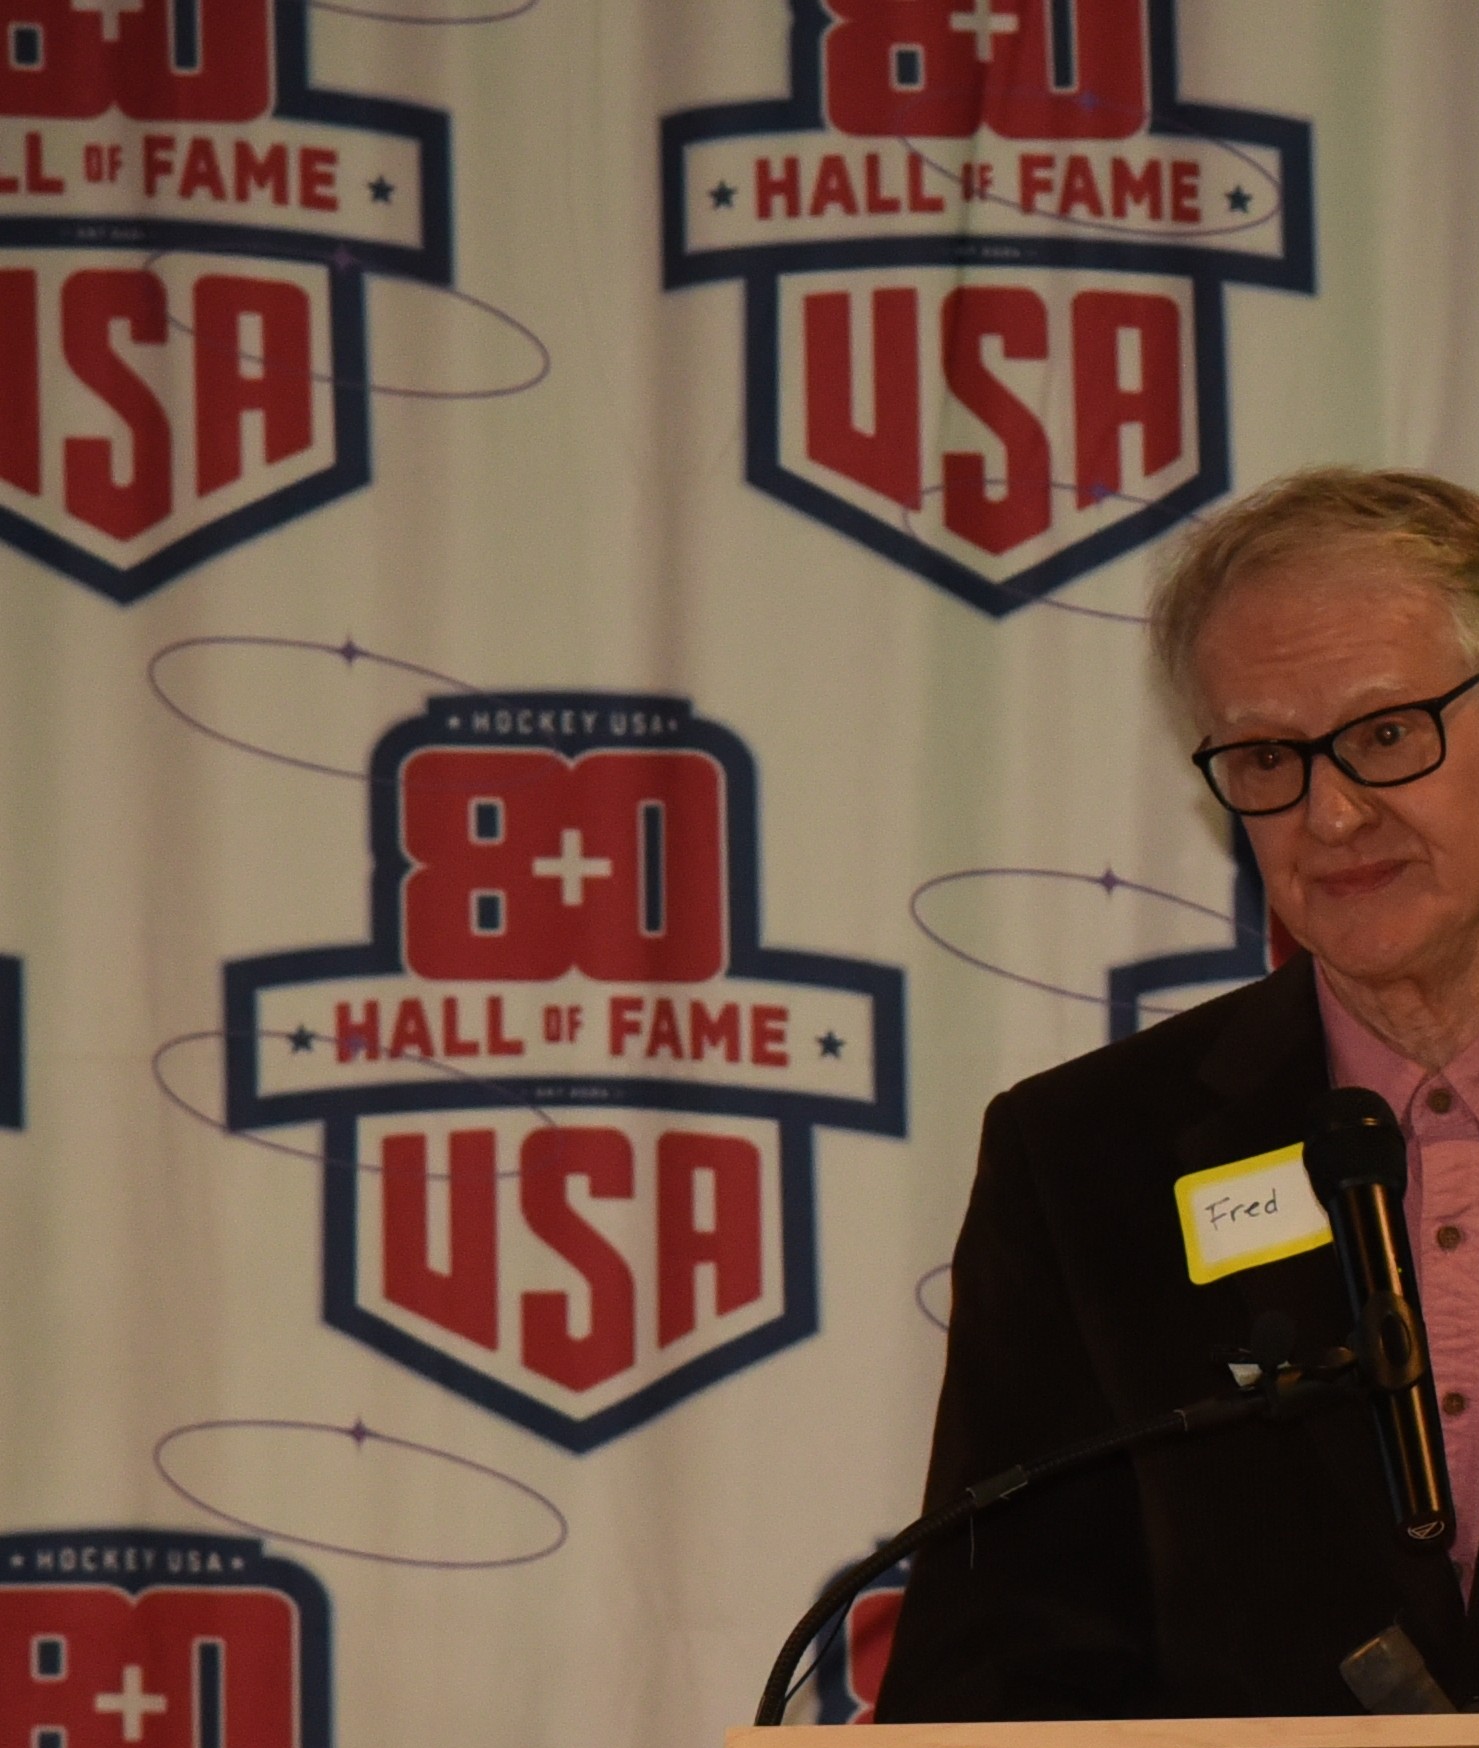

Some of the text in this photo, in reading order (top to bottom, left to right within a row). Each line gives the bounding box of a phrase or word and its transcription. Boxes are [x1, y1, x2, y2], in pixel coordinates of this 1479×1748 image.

[85, 145, 120, 181] OF
[143, 135, 336, 210] FAME
[757, 154, 1199, 222] HALL OF FAME
[805, 287, 1181, 554] USA
[472, 710, 664, 735] HOCKEY USA
[336, 997, 787, 1066] HALL OF FAME
[1205, 1188, 1279, 1231] Fred
[382, 1127, 761, 1391] USA
[37, 1548, 223, 1573] HOCKEY USA
